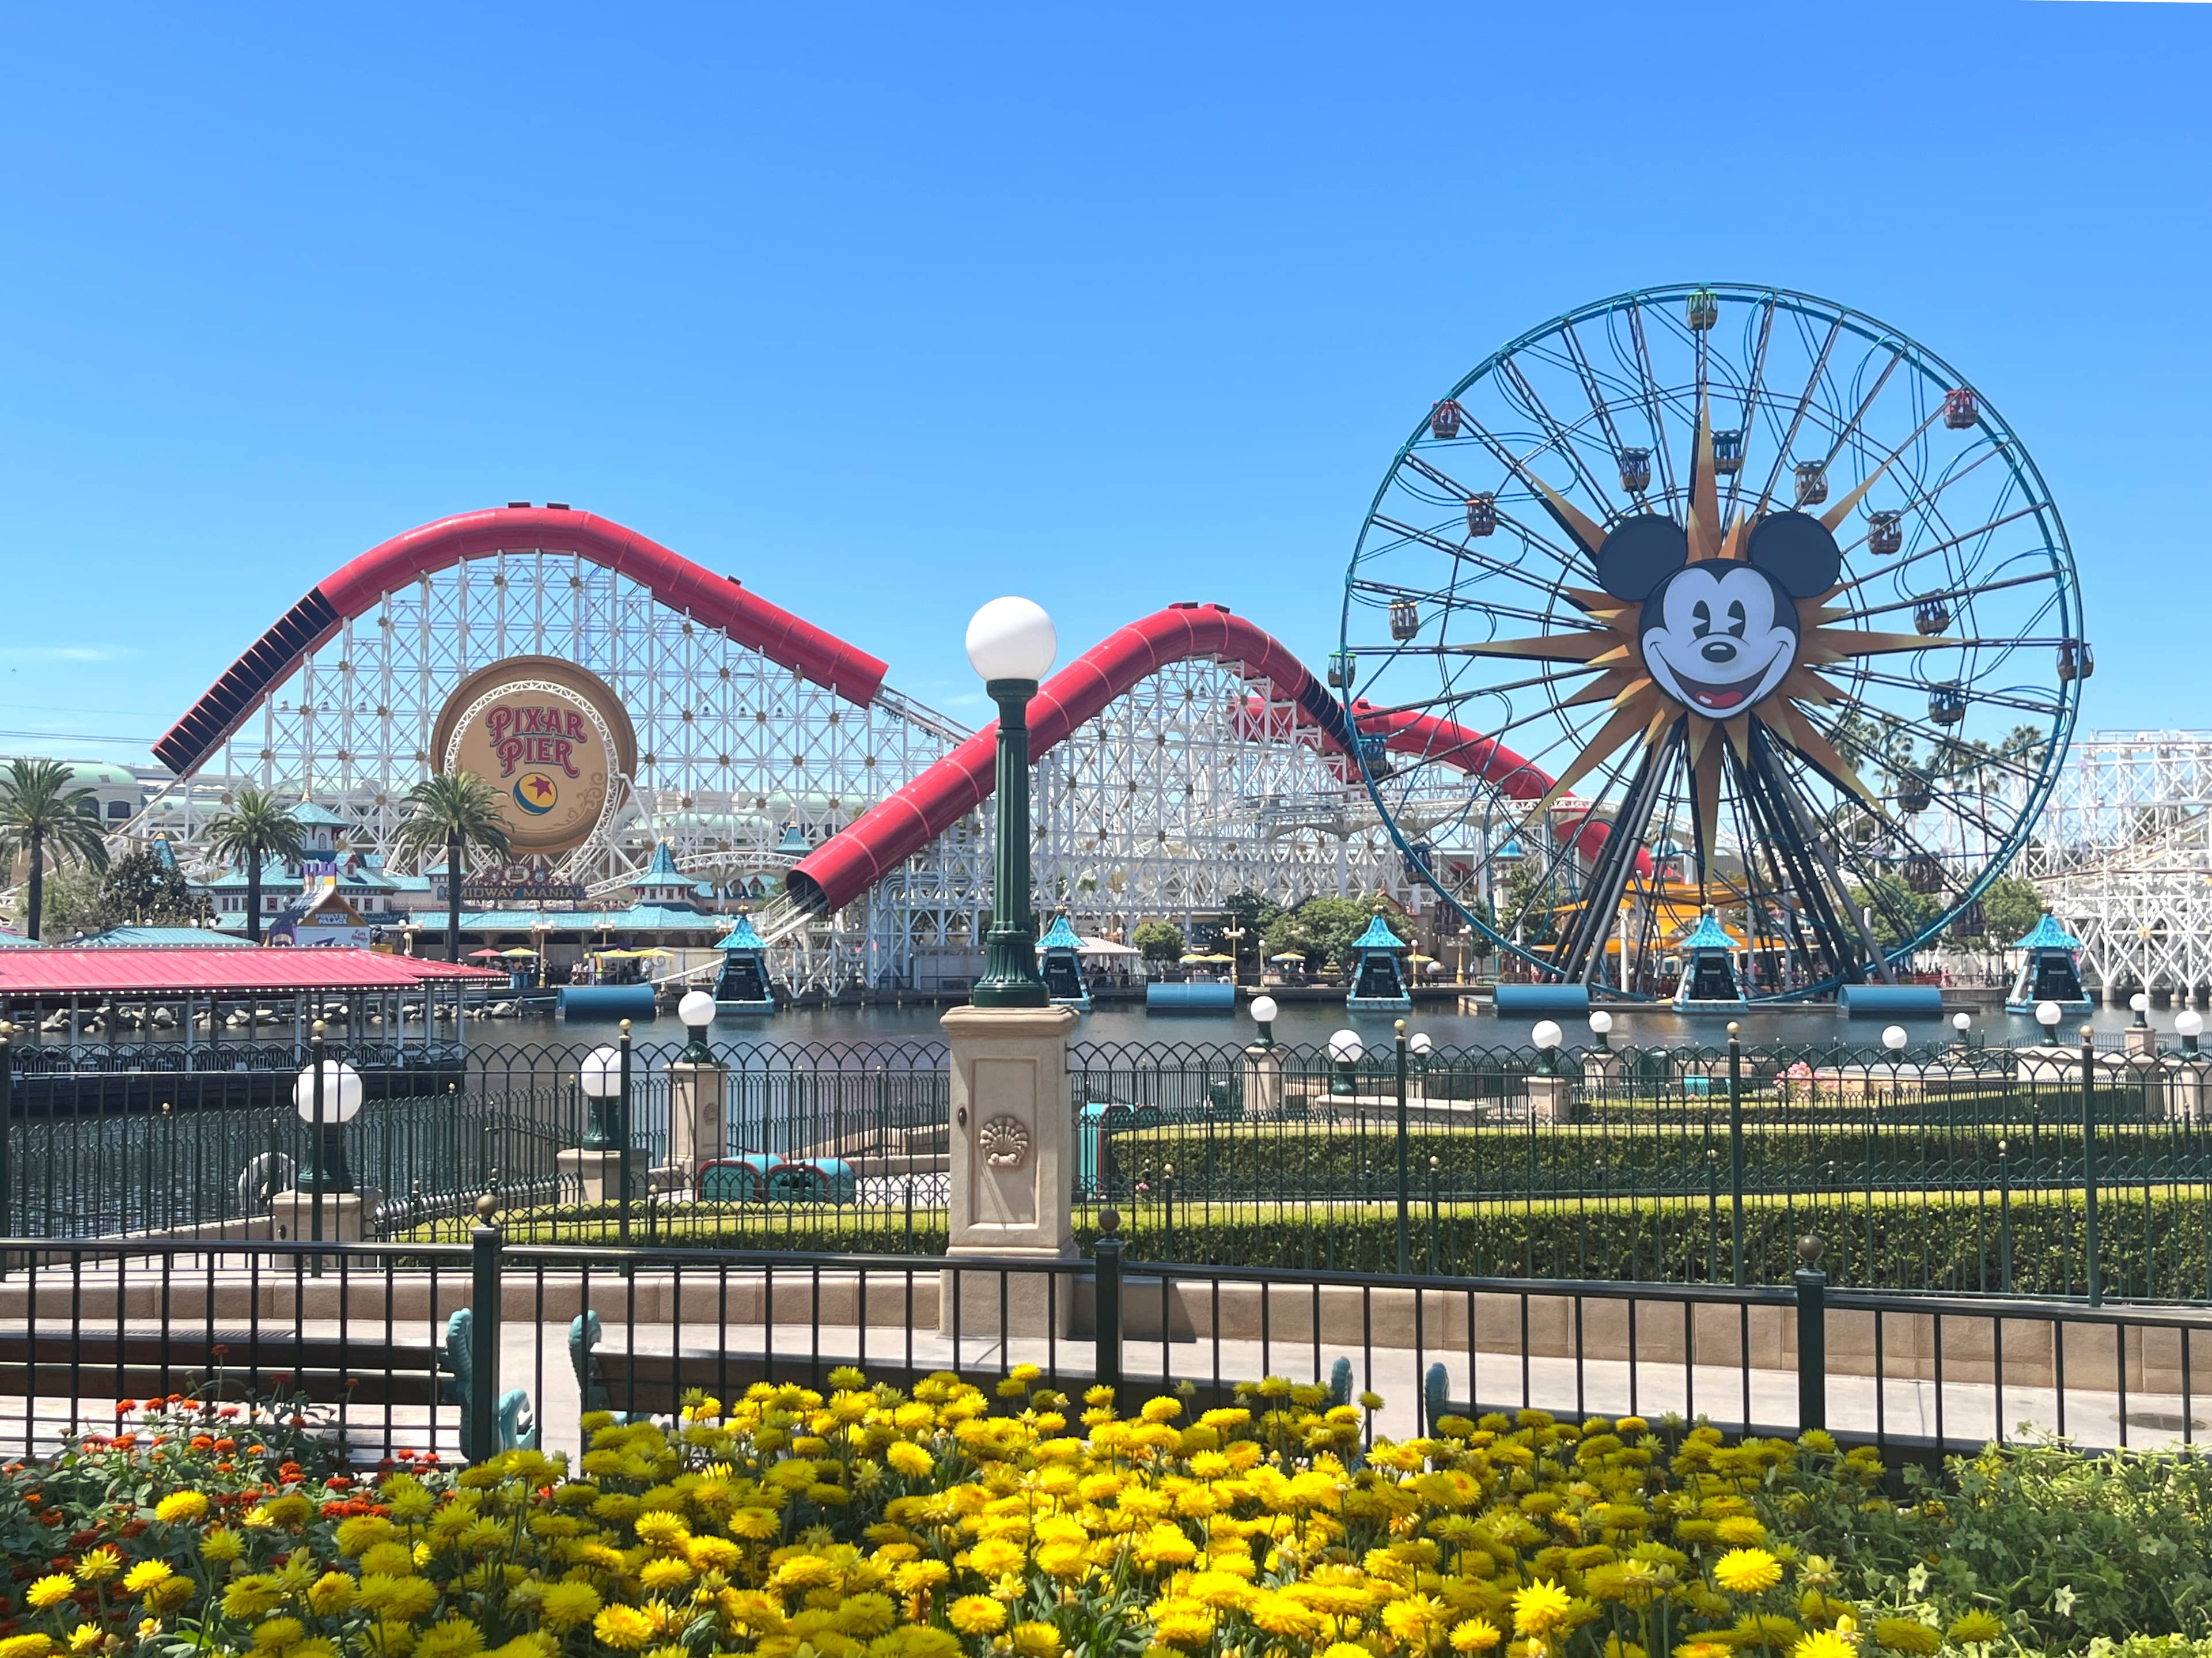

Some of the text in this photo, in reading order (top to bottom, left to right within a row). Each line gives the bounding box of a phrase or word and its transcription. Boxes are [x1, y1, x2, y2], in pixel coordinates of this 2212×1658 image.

[486, 705, 587, 747] PIXAR
[498, 737, 580, 778] PIER
[523, 887, 579, 898] MANIA!
